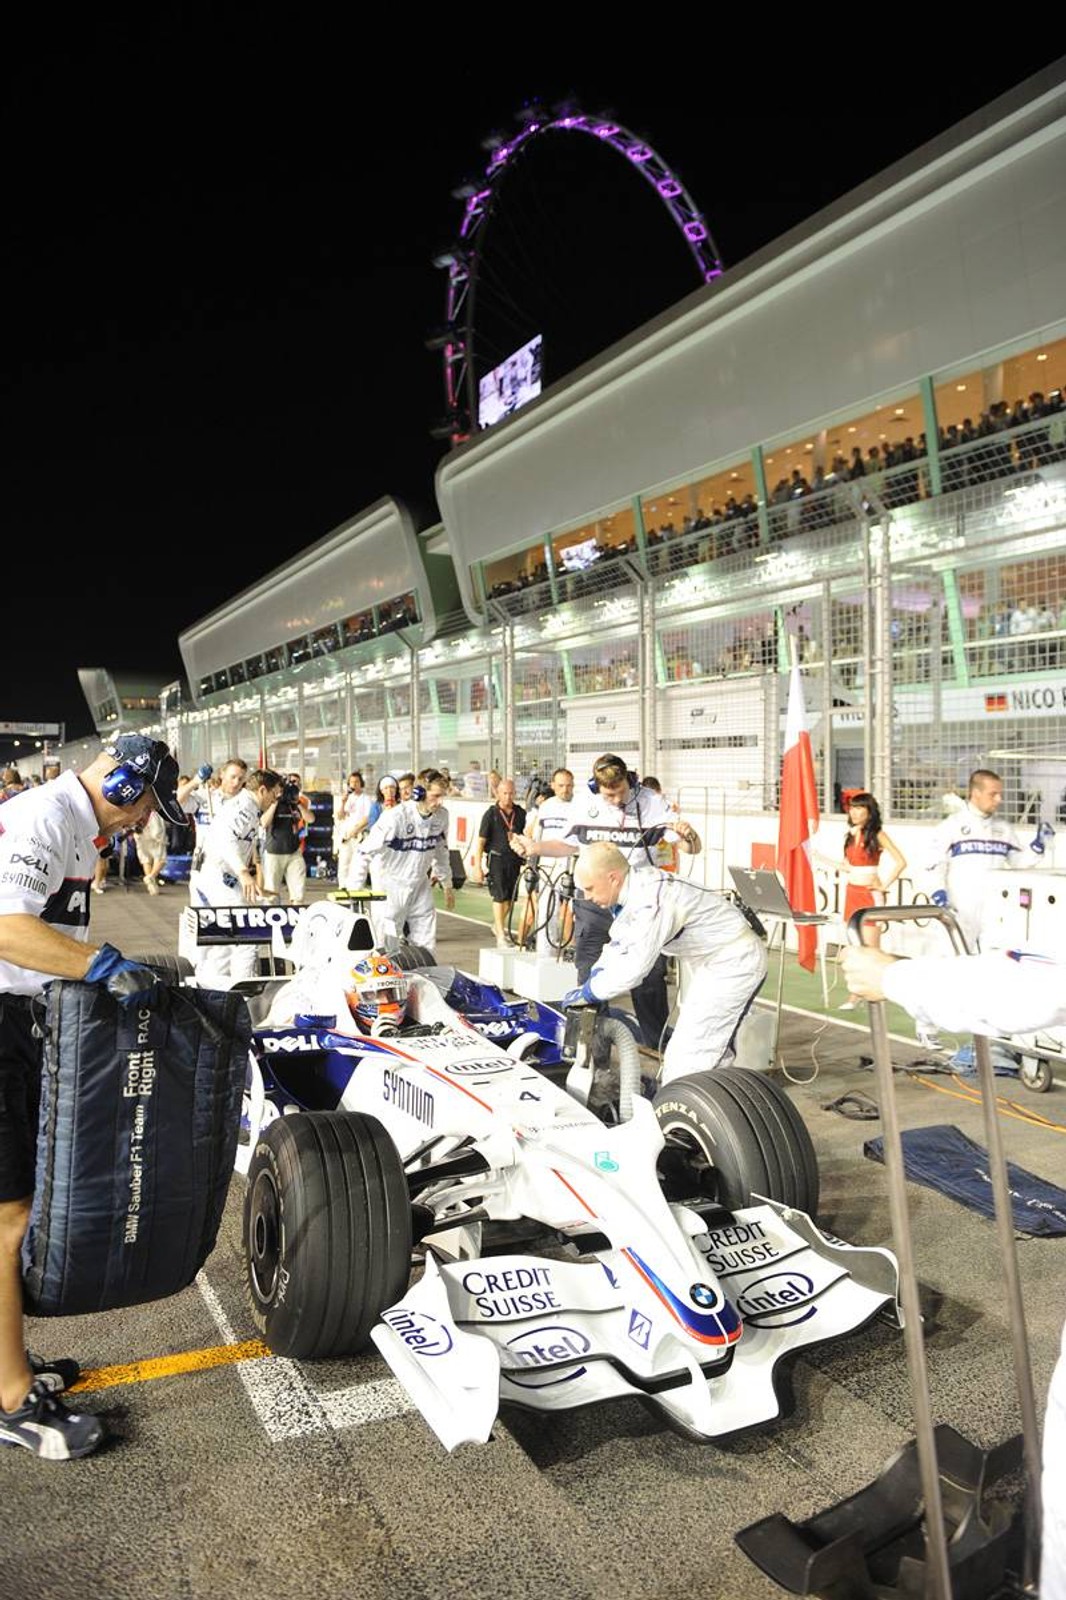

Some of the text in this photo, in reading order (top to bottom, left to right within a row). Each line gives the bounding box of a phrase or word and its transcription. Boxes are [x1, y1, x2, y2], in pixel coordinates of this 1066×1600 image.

[1012, 687, 1055, 711] NICO
[9, 853, 49, 876] DELL
[123, 1052, 141, 1098] Front
[137, 1050, 157, 1096] Right
[383, 1069, 435, 1129] SYNTIUM
[124, 1104, 145, 1244] BMW Sauber F1 Team
[690, 1220, 767, 1254] CREDIT
[706, 1241, 780, 1274] SUISSE
[462, 1267, 552, 1297] CREDIT
[739, 1280, 807, 1312] intel
[475, 1291, 561, 1319] SUISSE
[389, 1311, 440, 1354] intel
